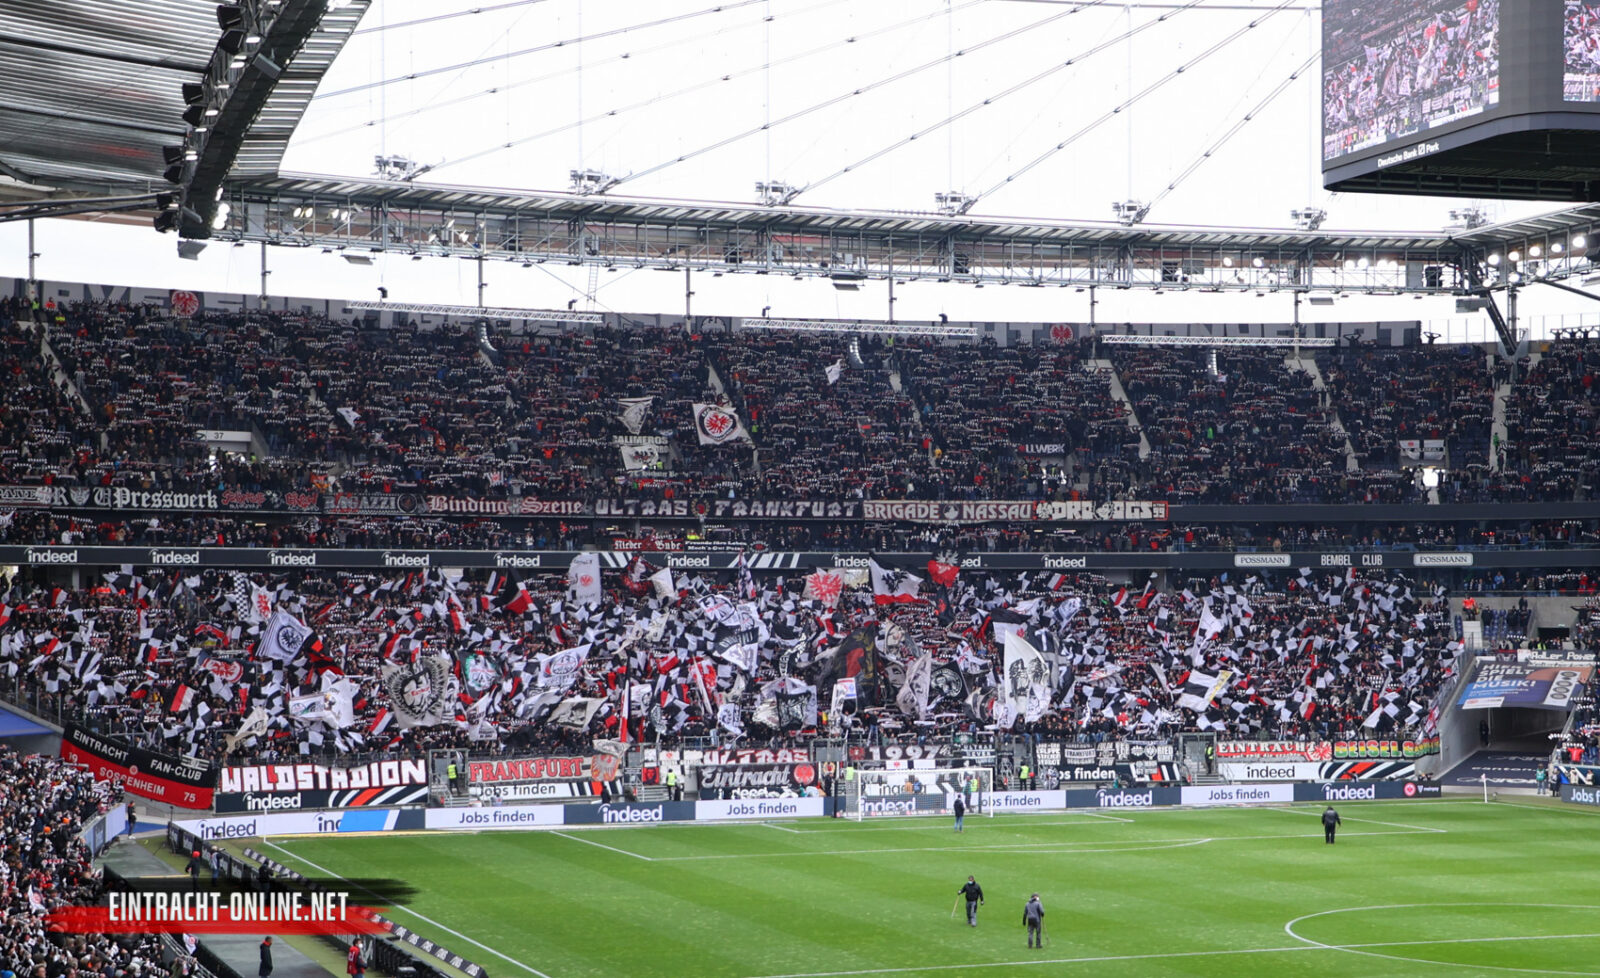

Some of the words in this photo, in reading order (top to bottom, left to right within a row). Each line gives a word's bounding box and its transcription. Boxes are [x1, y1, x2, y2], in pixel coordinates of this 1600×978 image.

[1377, 153, 1403, 168] Deutsche
[1403, 148, 1418, 160] Bank
[1426, 142, 1440, 154] Park
[213, 432, 225, 440] 37
[113, 486, 219, 509] Presswerk
[427, 495, 509, 515] Binding
[520, 495, 583, 515] Szene
[595, 500, 688, 516] ULTRAS
[715, 500, 860, 518] FRANKFURT
[863, 502, 939, 519] BRIGADE
[962, 502, 1033, 519] NASSAU
[27, 549, 78, 563] indeed
[152, 550, 200, 564] indeed
[271, 552, 316, 566] indeed
[385, 553, 430, 566] indeed
[496, 554, 541, 567] indeed
[667, 554, 710, 567] indeed
[1045, 556, 1086, 568] indeed
[1240, 556, 1286, 565] POSSMANN
[1321, 554, 1352, 566] BEMBEL
[1362, 554, 1383, 566] CLUB
[1419, 555, 1468, 564] POSSMANN
[1472, 680, 1536, 689] MUSIK!
[869, 746, 940, 760] 1997
[1218, 741, 1316, 753] EINTRACHT
[73, 729, 129, 762] EINTRACHT
[150, 759, 203, 781] FAN-CLUB
[702, 749, 809, 766] ULTRAS
[221, 759, 426, 793] WALDSTADION
[469, 757, 584, 783] FRANKFURT
[702, 765, 791, 787] Eintracht
[1074, 767, 1116, 780] finden
[1247, 766, 1296, 778] indeed
[513, 783, 556, 796] finden
[1208, 789, 1233, 801] Jobs
[1236, 788, 1270, 799] finden
[1326, 784, 1375, 800] indeed
[1570, 788, 1594, 804] Jobs
[184, 792, 196, 802] 75
[247, 792, 302, 810] indeed
[1005, 795, 1041, 807] finden
[1100, 790, 1153, 807] indeed
[727, 804, 755, 815] Jobs
[759, 803, 797, 814] finden
[860, 797, 916, 812] indeed
[459, 812, 489, 824] Jobs
[493, 811, 535, 822] finden
[602, 805, 663, 823] indeed
[200, 819, 257, 840] indeed
